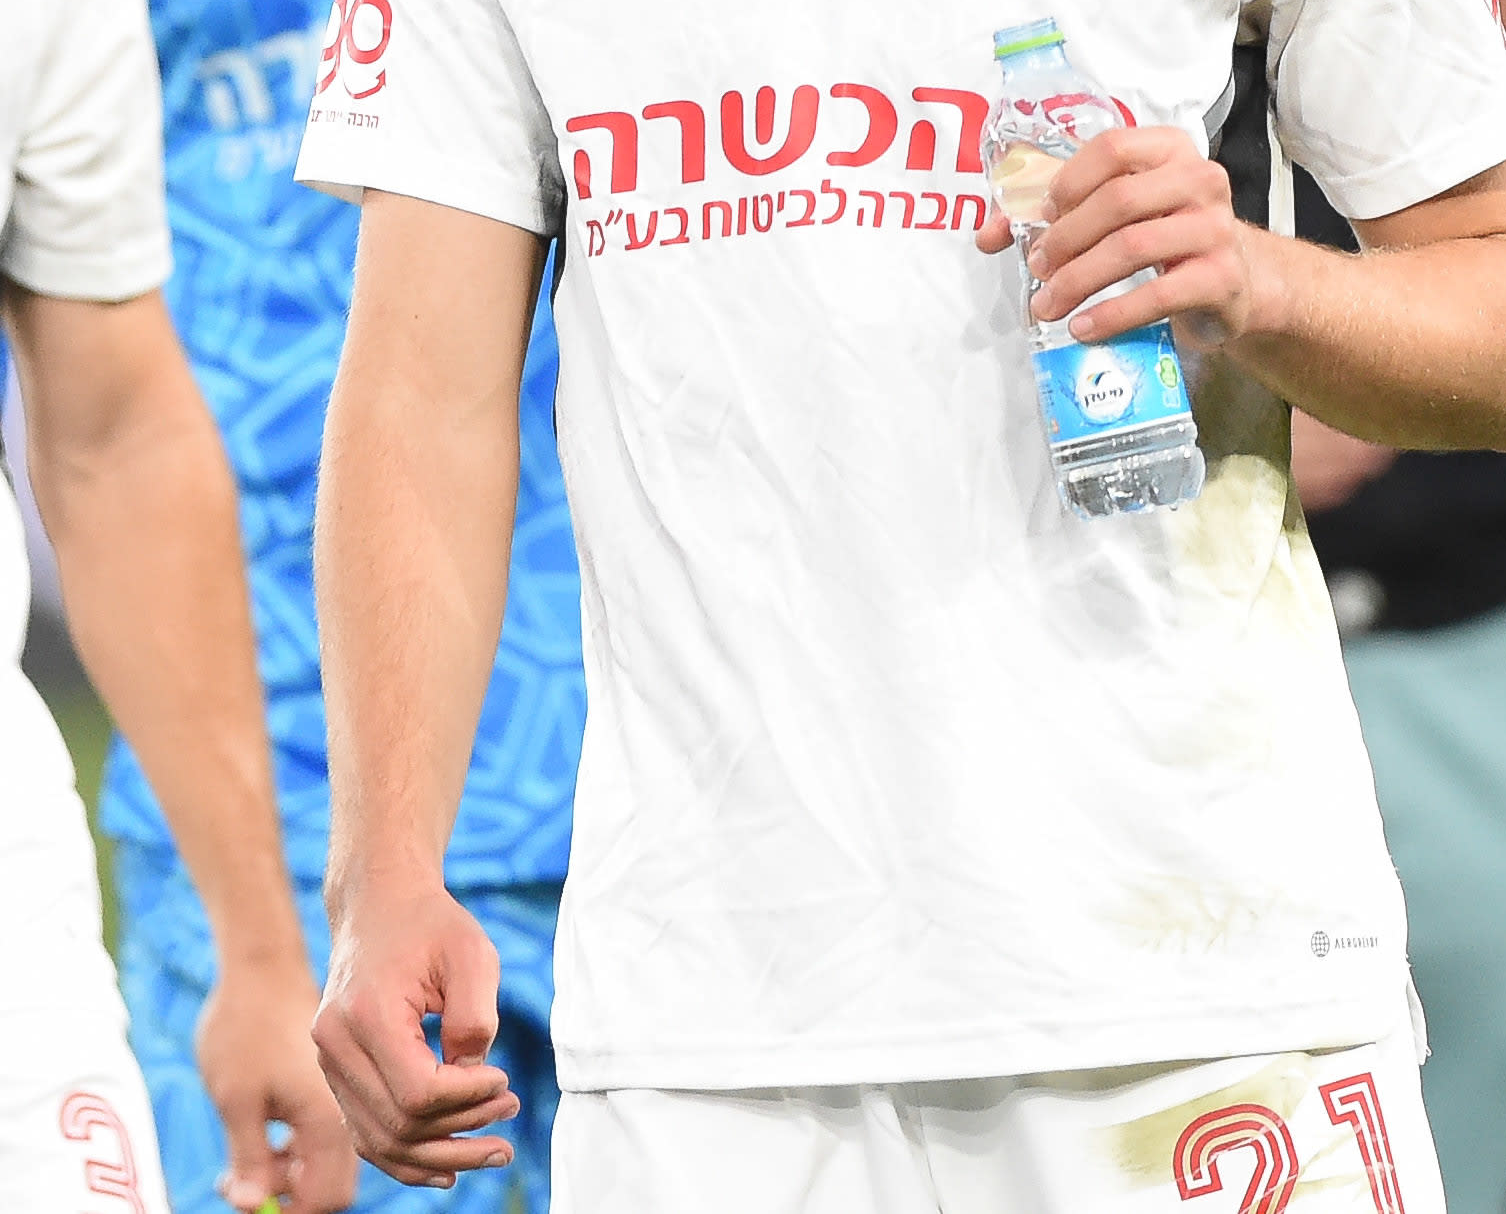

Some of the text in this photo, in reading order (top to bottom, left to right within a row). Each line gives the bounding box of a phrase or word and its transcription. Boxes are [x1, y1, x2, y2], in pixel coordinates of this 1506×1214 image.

[566, 82, 990, 200] הכשרה
[702, 179, 847, 240] לביטוח
[857, 189, 987, 231] חברה
[1173, 1072, 1406, 1214] 21
